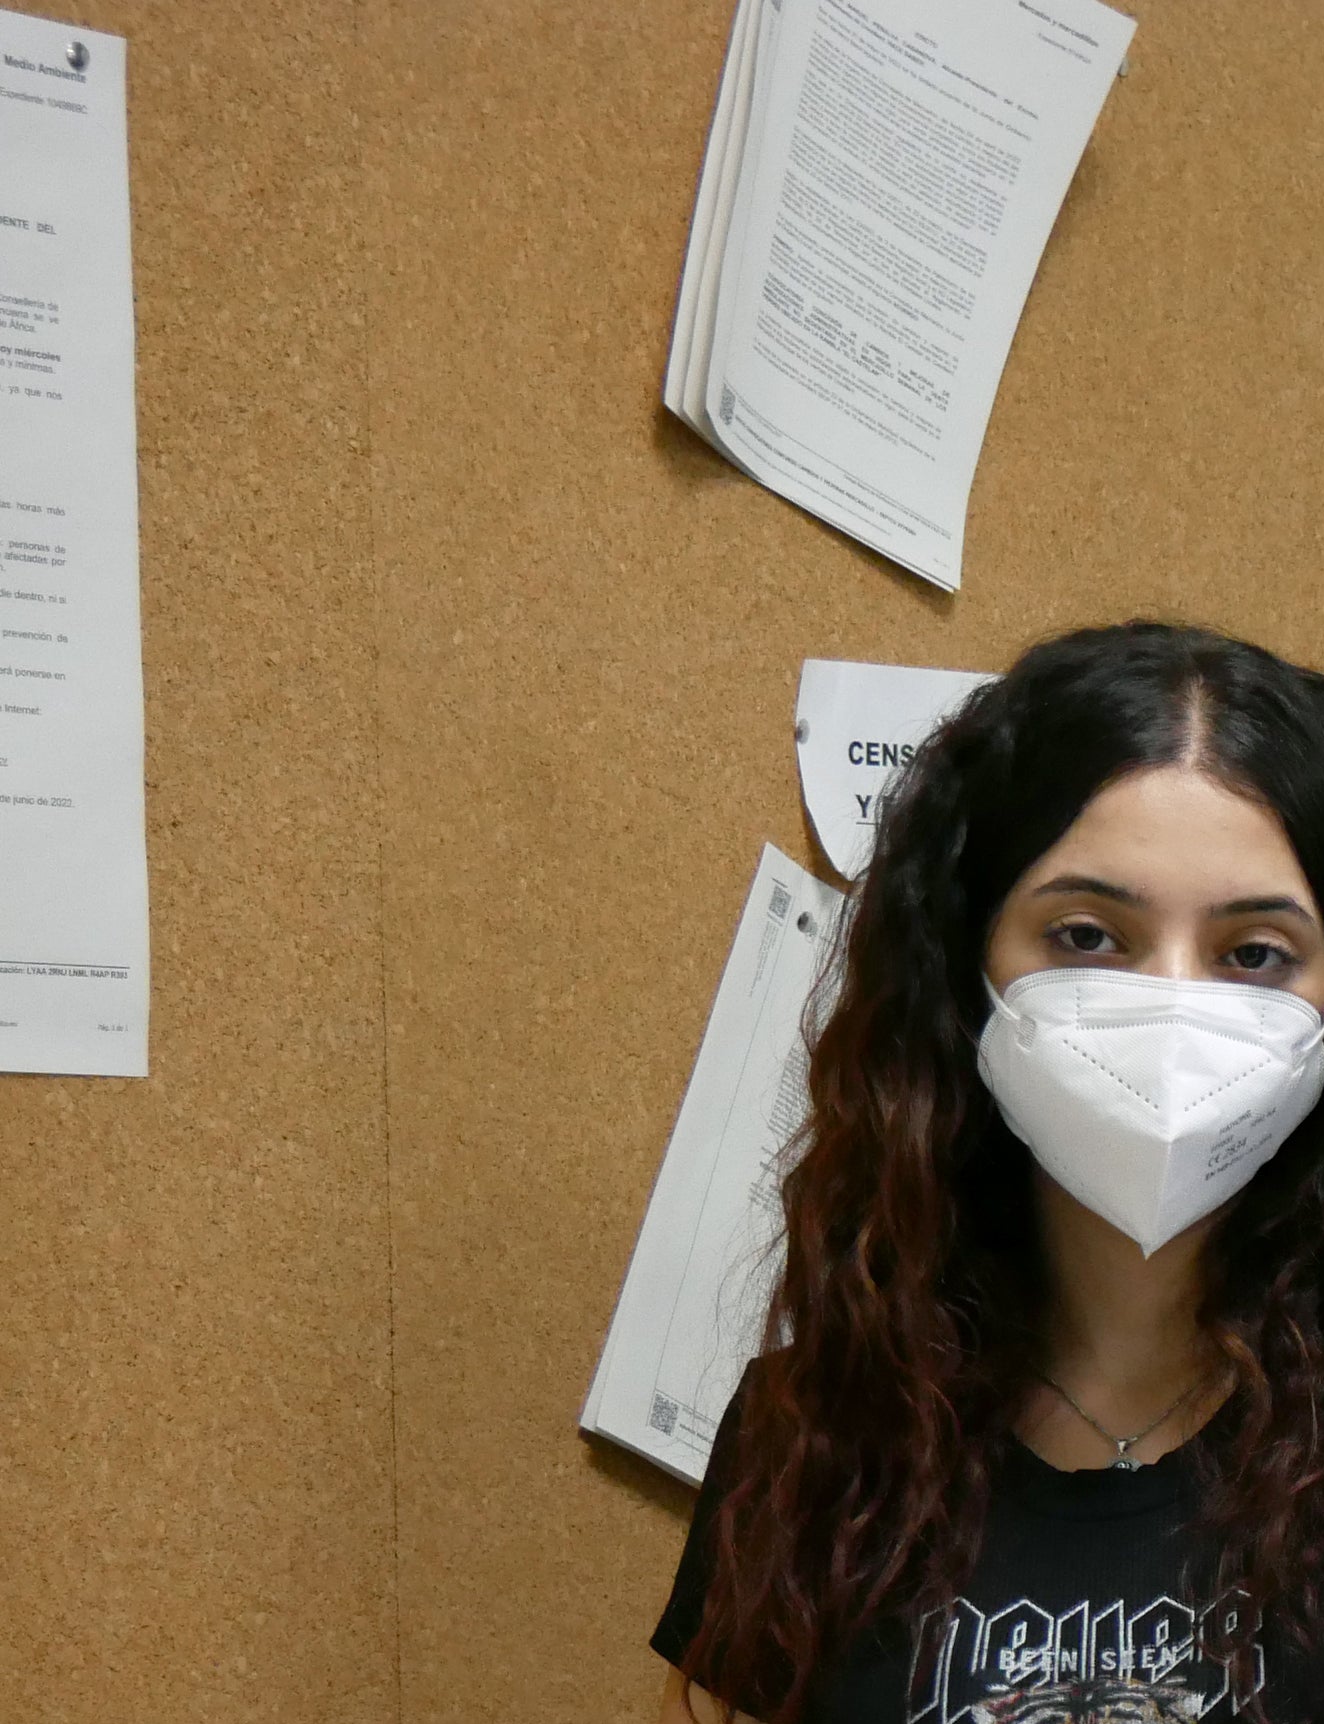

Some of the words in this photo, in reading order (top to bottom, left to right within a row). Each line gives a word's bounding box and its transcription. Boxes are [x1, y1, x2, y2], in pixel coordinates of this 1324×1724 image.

[4, 54, 36, 72] Medio
[38, 63, 87, 83] Ambiente
[36, 222, 57, 235] DEL
[24, 387, 42, 400] que
[46, 390, 63, 401] nos
[8, 540, 50, 554] personas
[54, 544, 66, 554] de
[4, 551, 48, 565] afectadas
[51, 556, 66, 567] por
[3, 628, 52, 643] prevención
[54, 672, 66, 680] en
[855, 795, 872, 818] Y
[999, 1646, 1078, 1672] BEEN
[1100, 1645, 1178, 1672] SEEN
